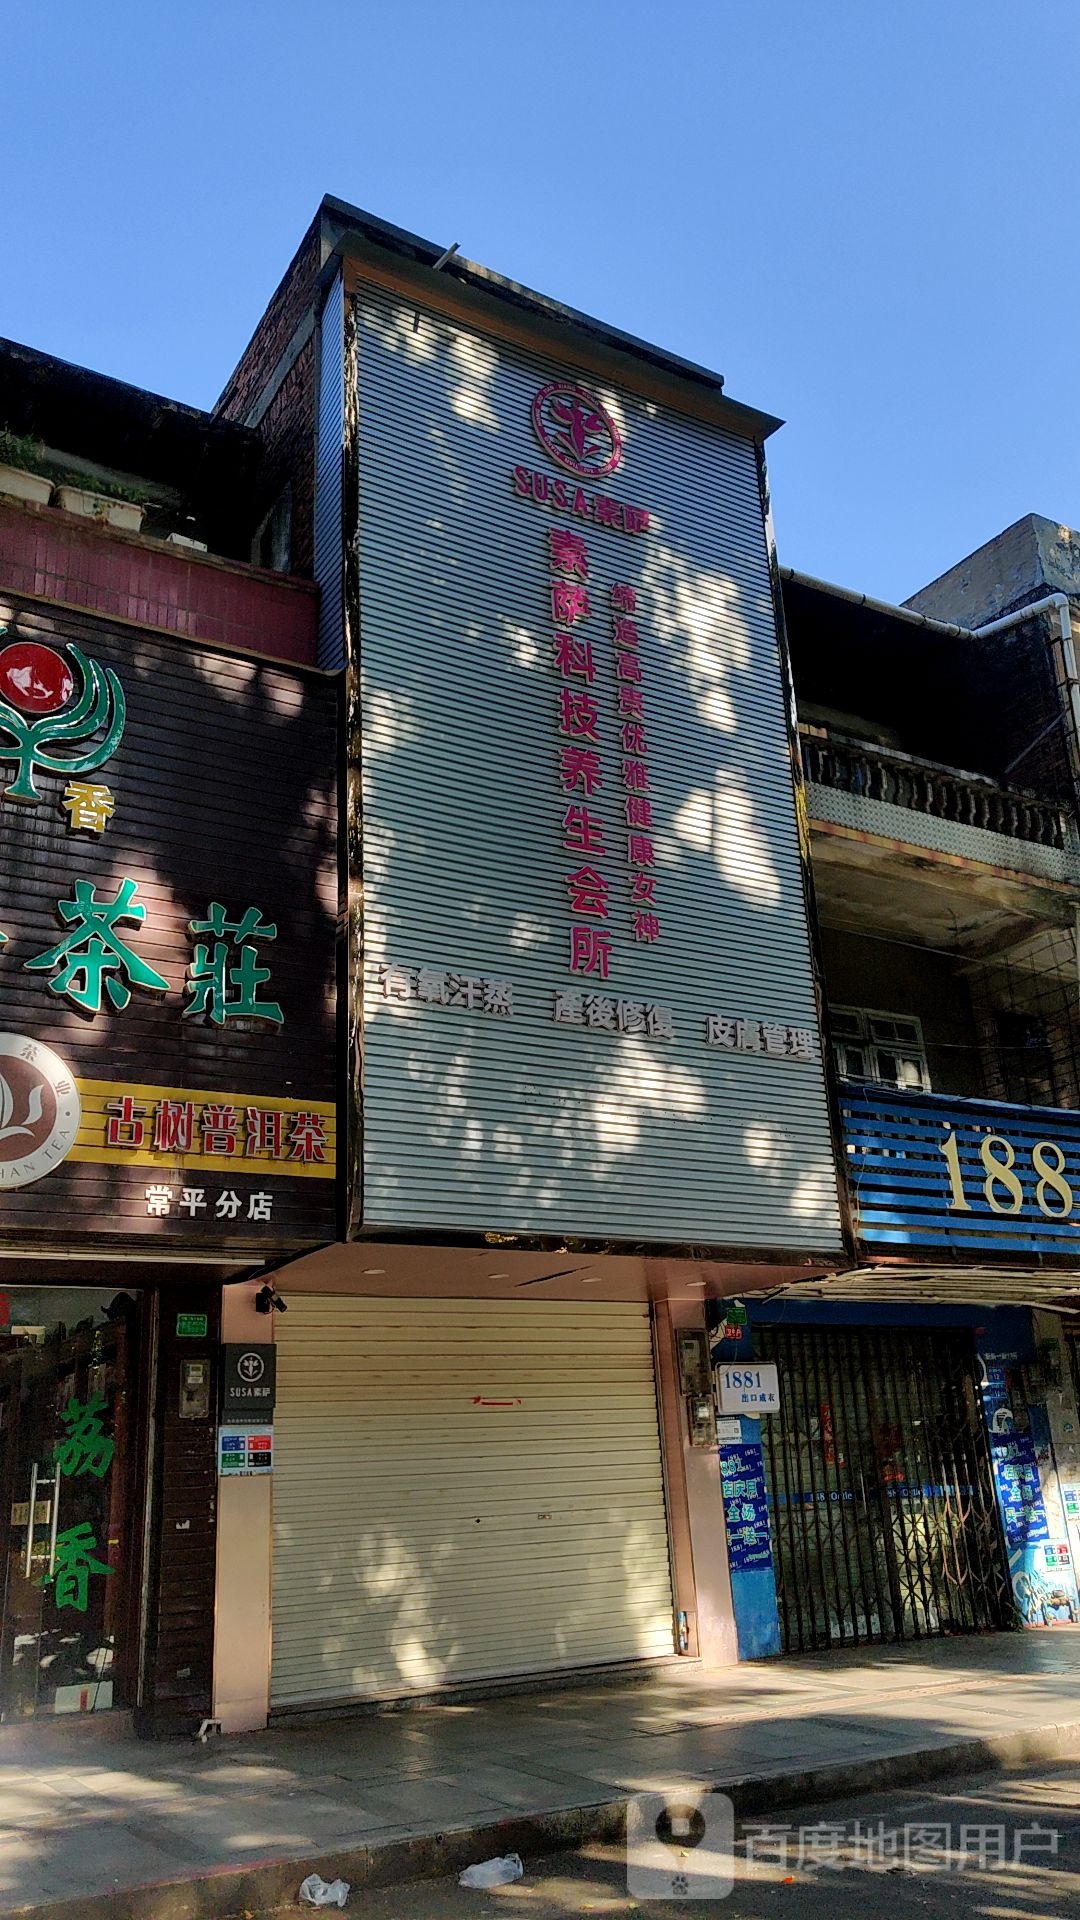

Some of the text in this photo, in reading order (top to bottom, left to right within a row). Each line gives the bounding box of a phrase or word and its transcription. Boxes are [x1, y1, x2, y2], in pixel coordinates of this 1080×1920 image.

[62, 781, 116, 833] 香
[0, 877, 285, 1028] 茶莊
[42, 1129, 70, 1160] TEA
[104, 1095, 329, 1162] 古树普洱茶
[145, 1184, 273, 1222] 常平分店
[725, 1371, 762, 1389] 1881
[722, 1480, 757, 1498] 店庆月
[727, 1503, 755, 1521] 全场
